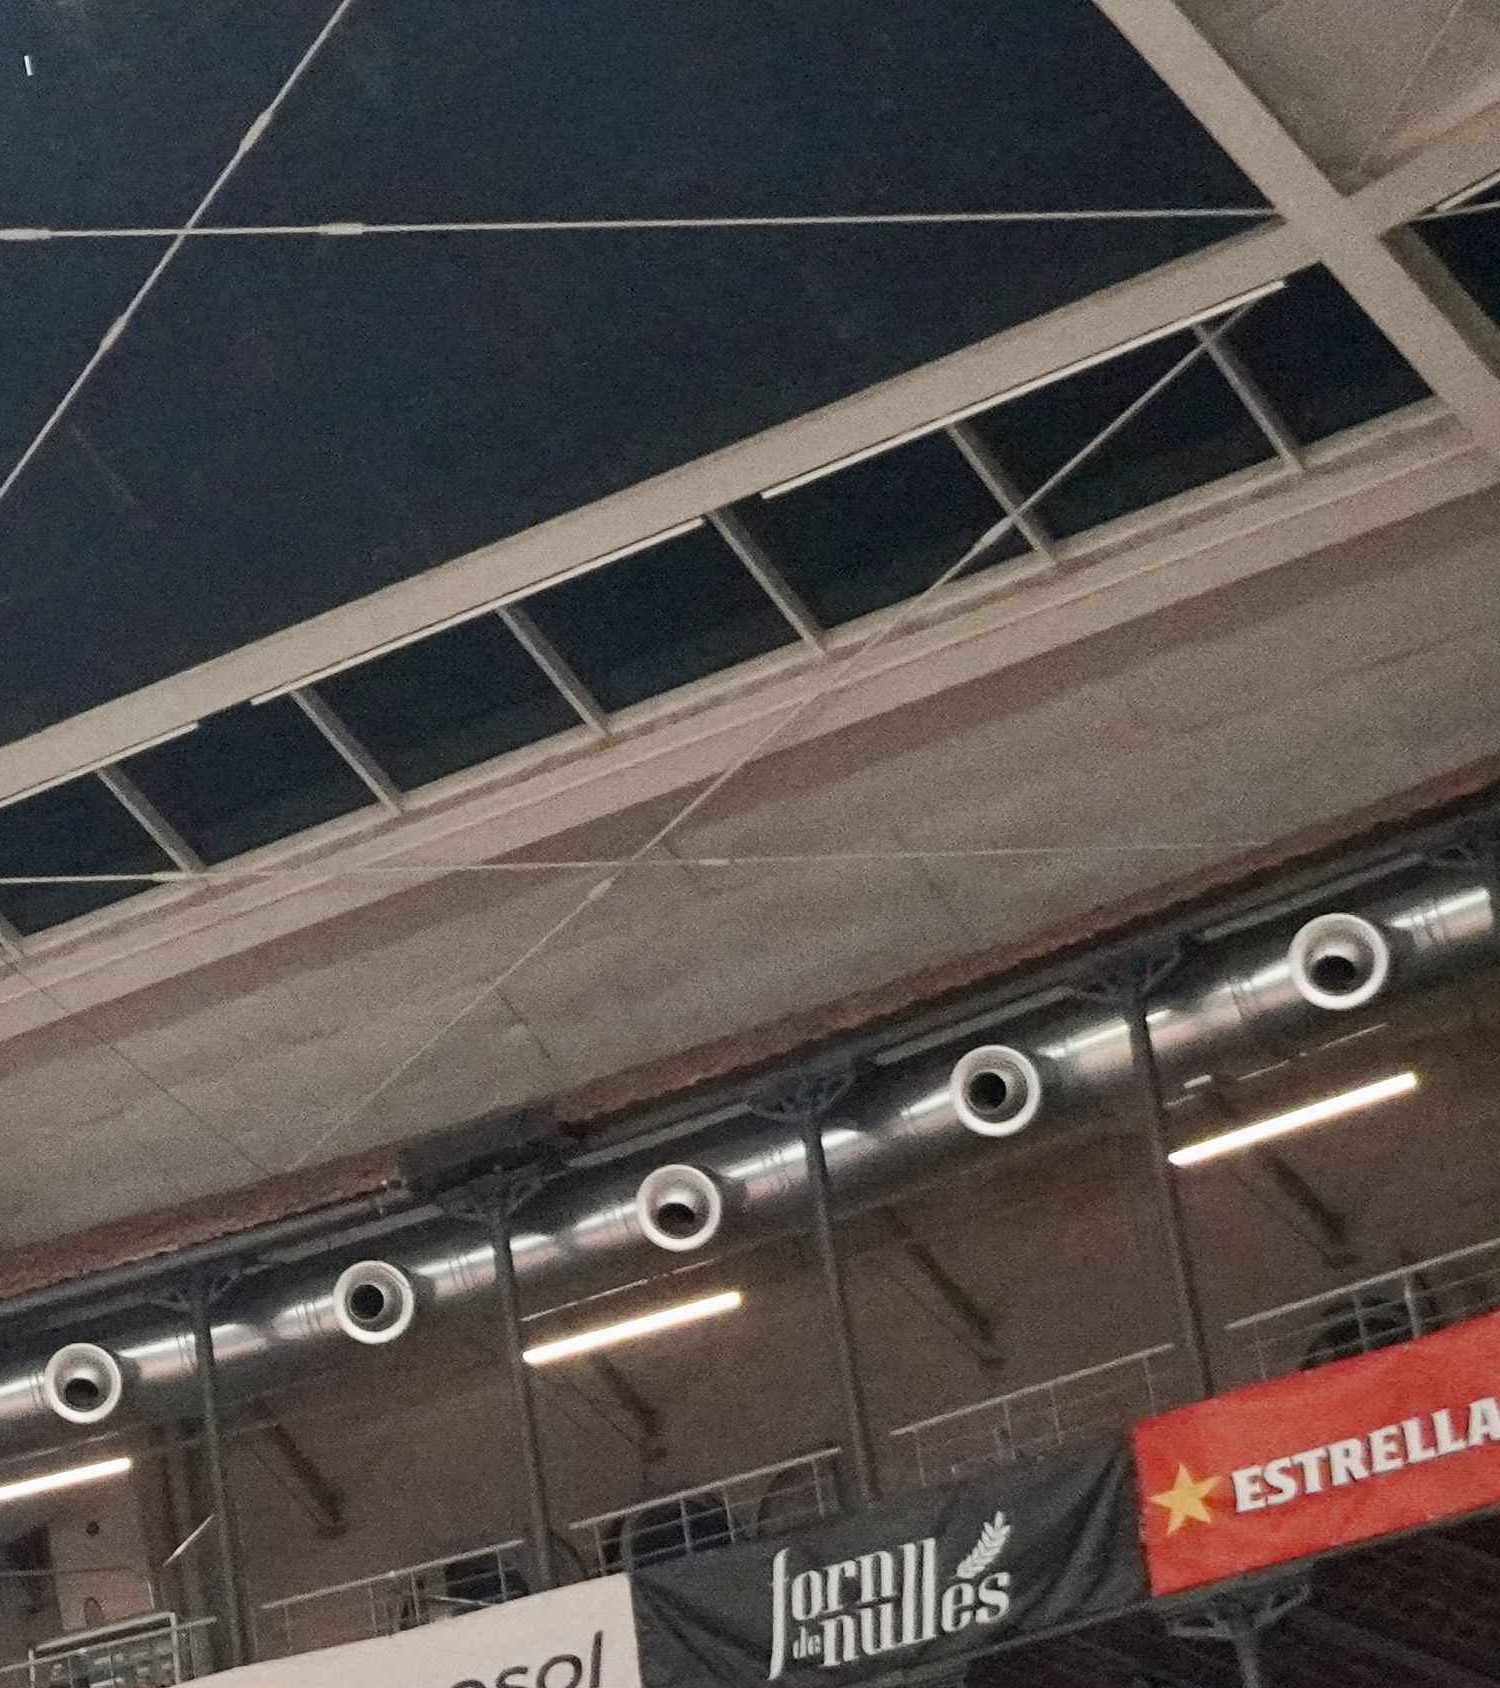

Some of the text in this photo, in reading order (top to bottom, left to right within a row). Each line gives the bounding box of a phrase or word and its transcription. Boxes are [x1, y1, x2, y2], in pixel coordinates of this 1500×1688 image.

[1233, 1397, 1500, 1512] ESTRELLA
[767, 1547, 895, 1681] forn
[793, 1630, 822, 1658] de
